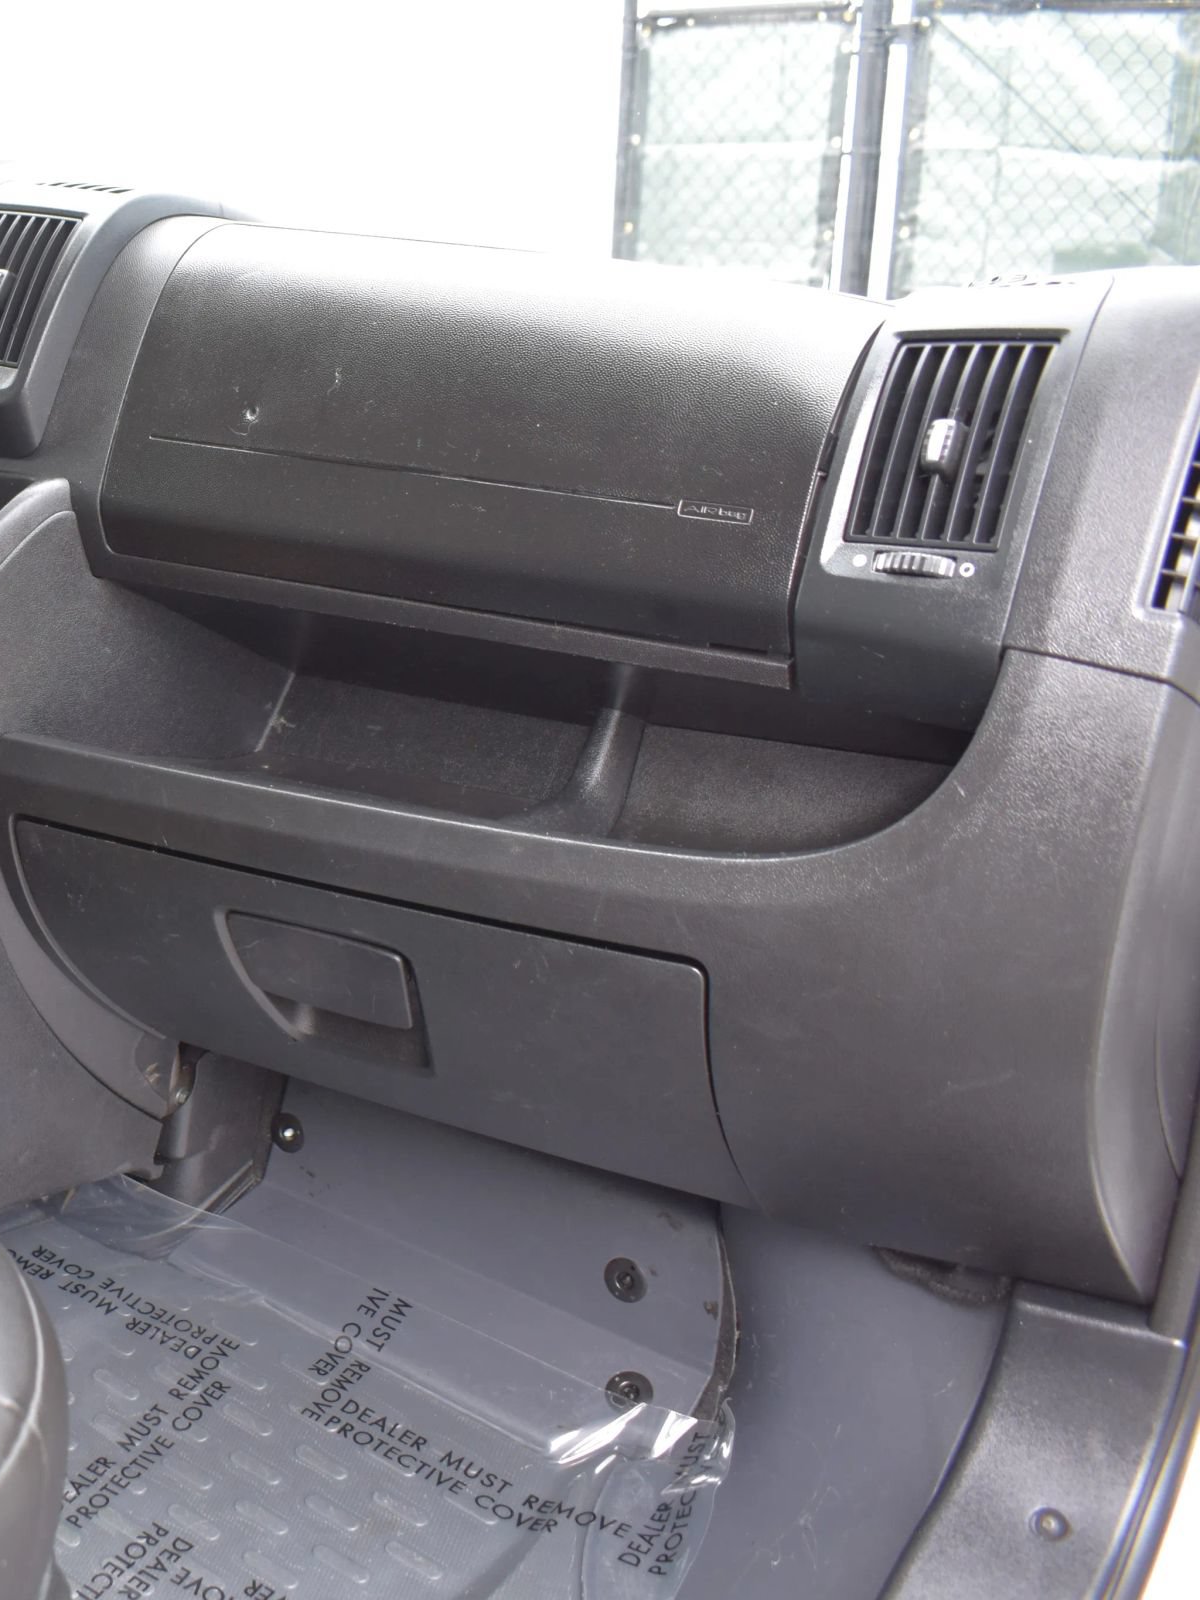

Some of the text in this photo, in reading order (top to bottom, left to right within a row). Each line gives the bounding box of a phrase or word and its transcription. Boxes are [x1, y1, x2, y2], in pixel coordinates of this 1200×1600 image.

[7, 1249, 202, 1360] DEALER MUST REM
[31, 1244, 219, 1346] PROTECTIVE COVER
[307, 1321, 362, 1377] COVER
[300, 1297, 414, 1422] MUST REMOVE
[63, 1337, 241, 1504] EALER MUST REMOVE
[65, 1380, 233, 1529] PROTECTIVE COVER
[323, 1416, 559, 1534] PROTECTIVE COVER
[339, 1399, 633, 1538] DEALER MUST REMOVE
[75, 1521, 170, 1600] PROTECTI
[117, 1536, 195, 1600] DEALER
[617, 1499, 675, 1568] DEALER
